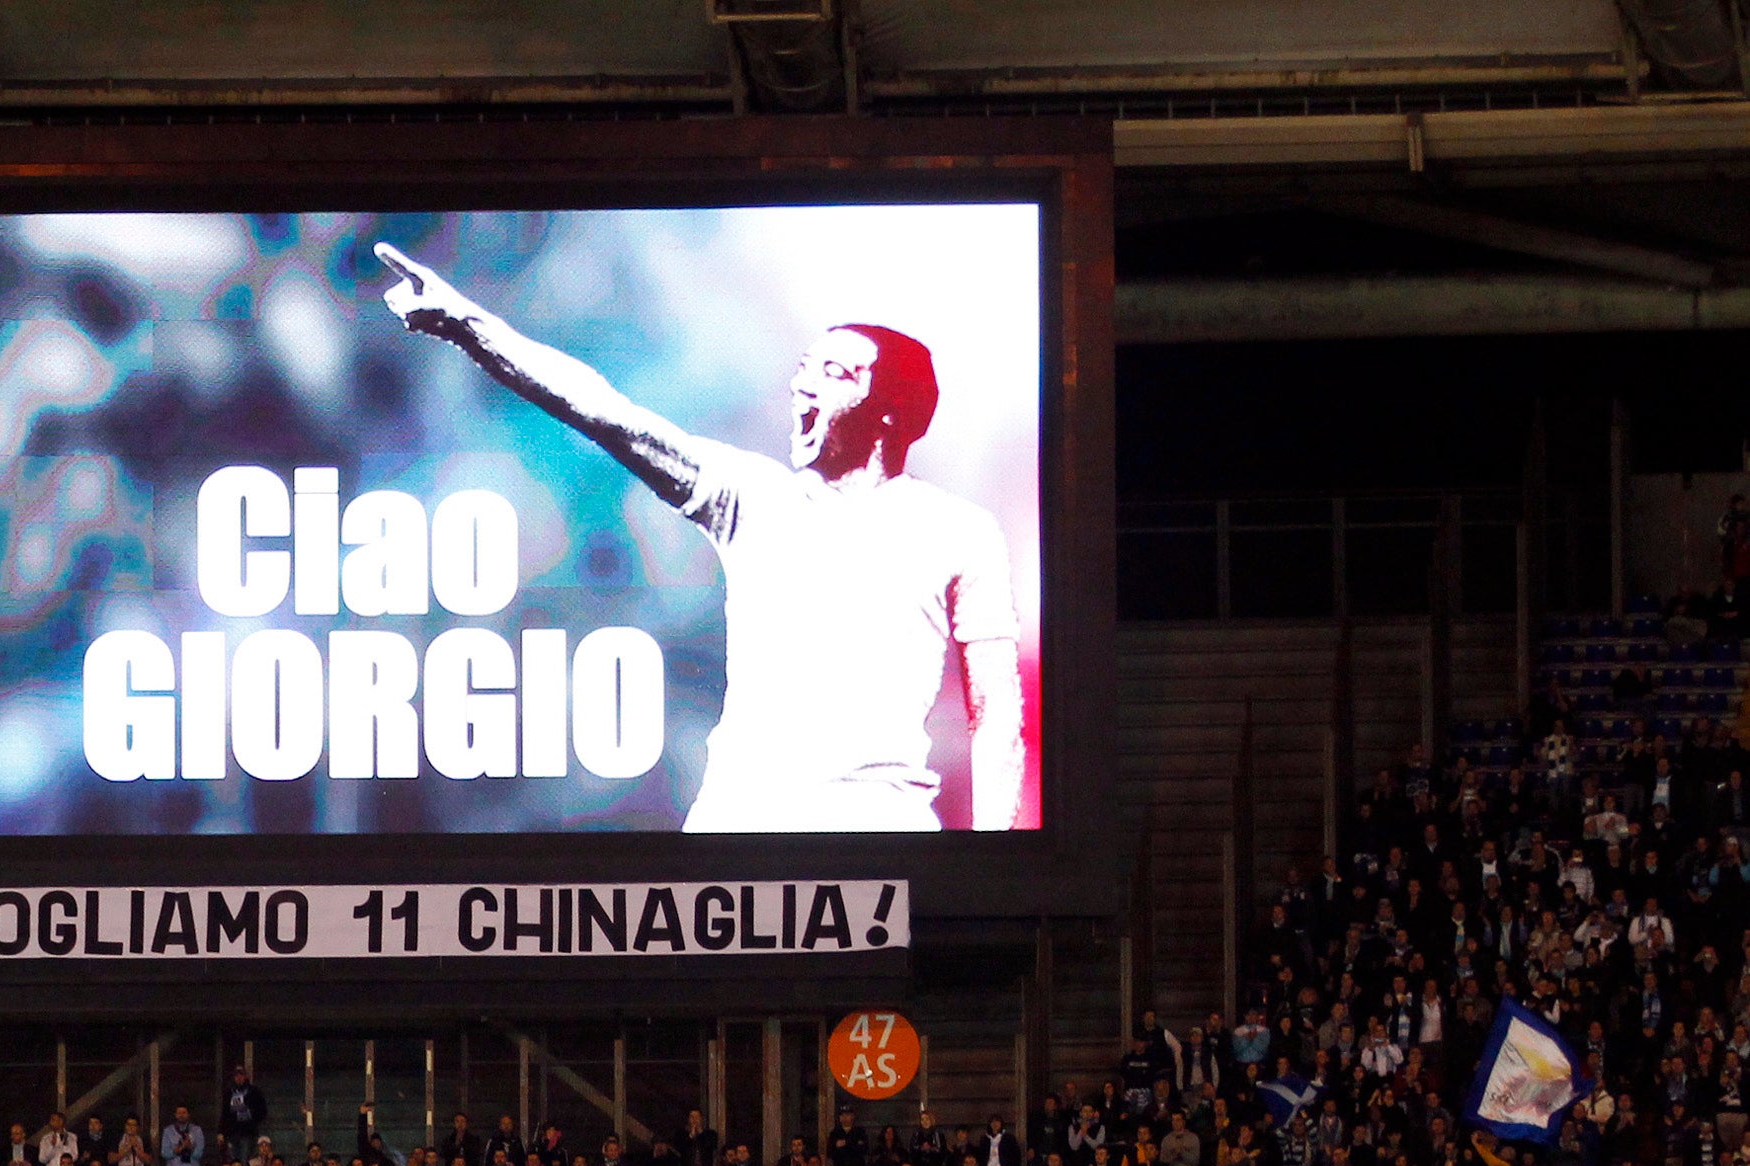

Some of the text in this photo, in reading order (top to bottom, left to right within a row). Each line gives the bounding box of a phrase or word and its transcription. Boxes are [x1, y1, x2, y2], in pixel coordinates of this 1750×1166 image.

[197, 465, 518, 617] Ciao
[83, 626, 665, 781] GIORGIO
[353, 890, 419, 952] 11
[457, 884, 897, 953] CHINAGLIA!
[849, 1014, 896, 1049] 47
[847, 1053, 897, 1090] AS
